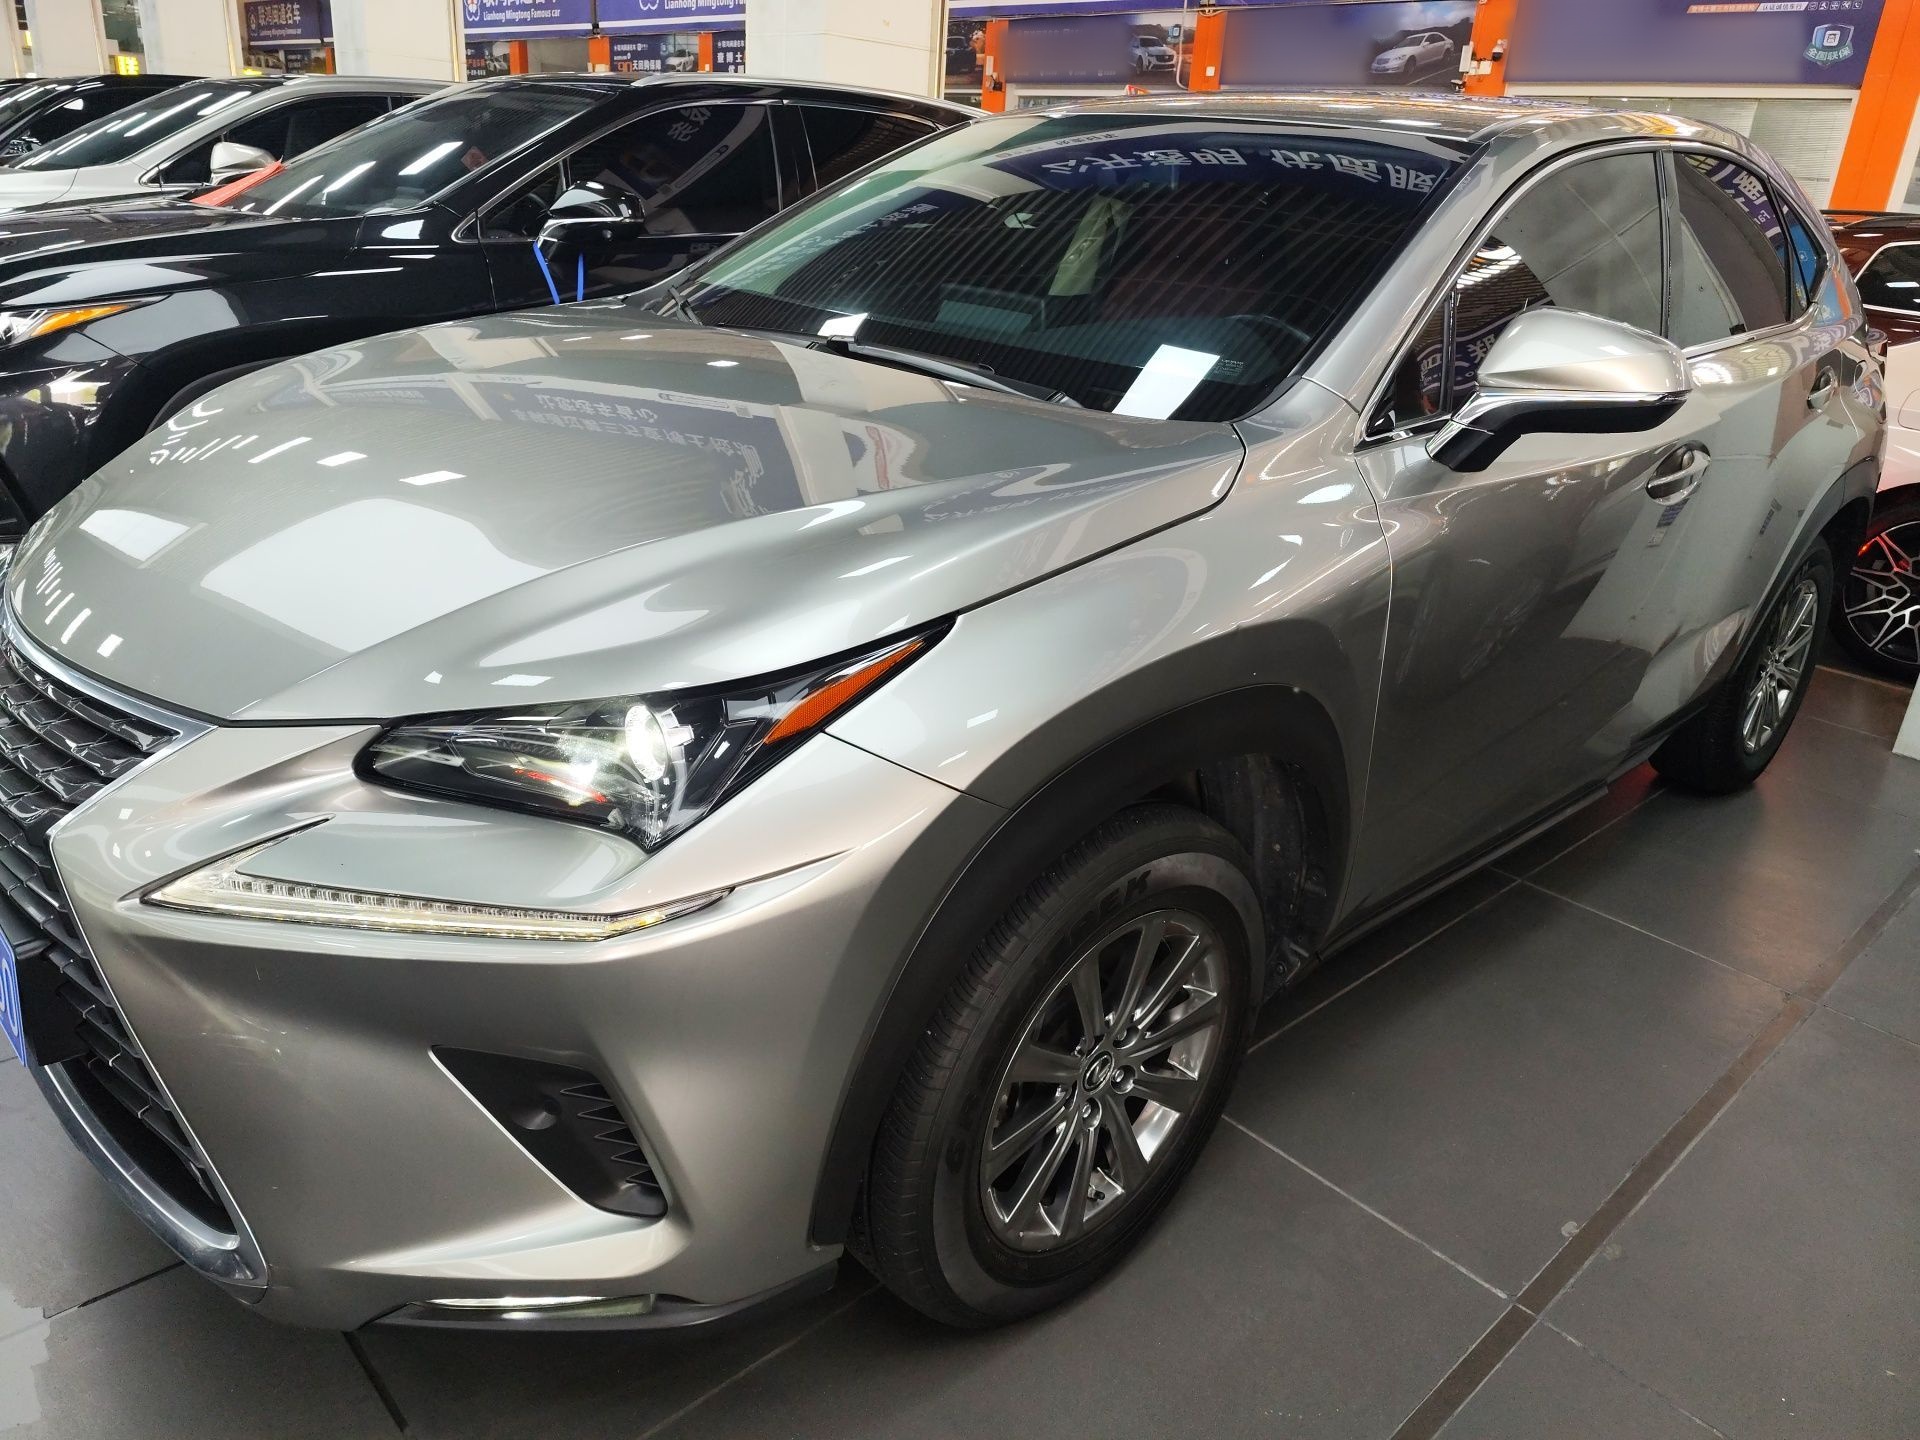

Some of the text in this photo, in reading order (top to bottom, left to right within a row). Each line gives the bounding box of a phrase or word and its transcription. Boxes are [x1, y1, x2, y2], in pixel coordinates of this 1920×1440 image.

[483, 9, 560, 22] Lianhong Mingtong Famous car
